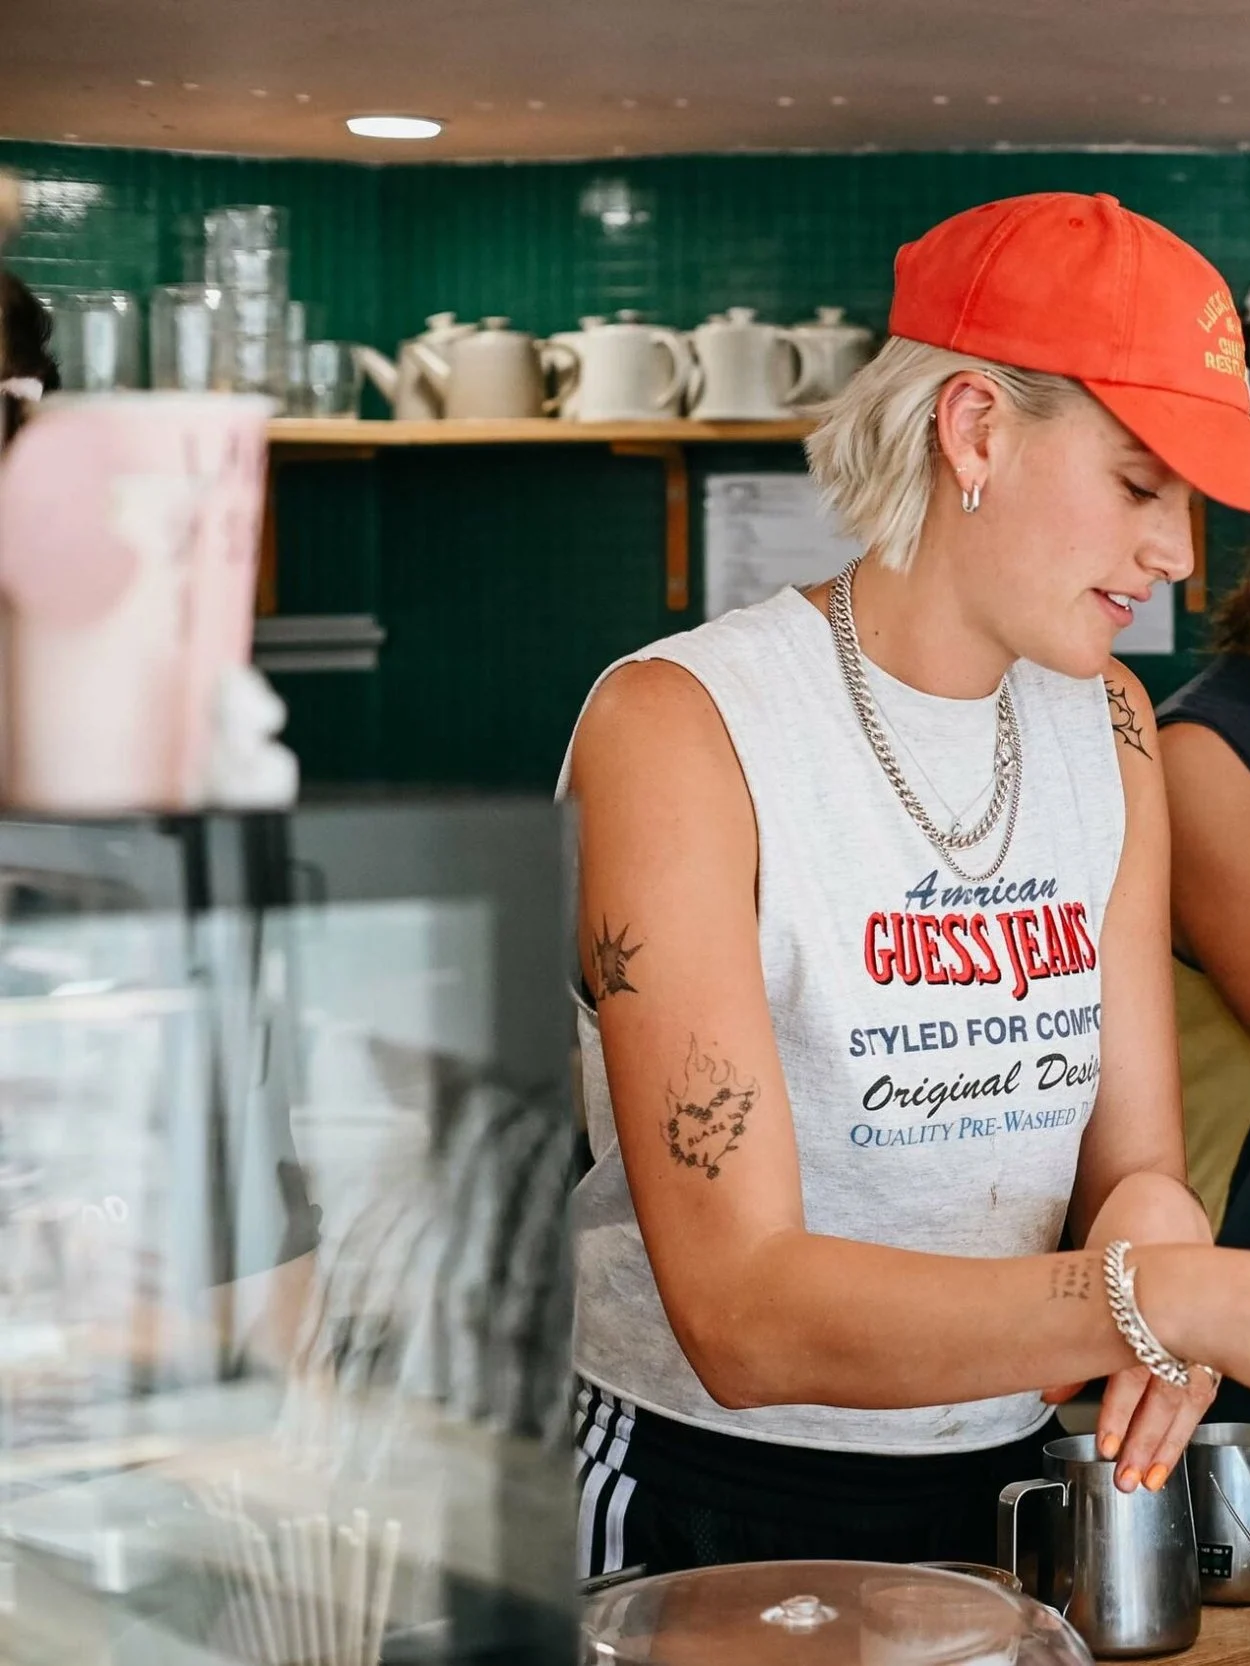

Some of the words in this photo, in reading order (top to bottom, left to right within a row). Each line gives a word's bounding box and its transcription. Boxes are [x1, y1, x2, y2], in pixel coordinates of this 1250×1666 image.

[864, 911, 1001, 987] GUESS
[996, 901, 1097, 1001] JEANS
[849, 1020, 959, 1057] STYLED
[967, 1015, 1029, 1047] FOR
[862, 1060, 1022, 1119] Original
[850, 1121, 955, 1150] QUALITY
[958, 1107, 1077, 1140] PRE-WASHED
